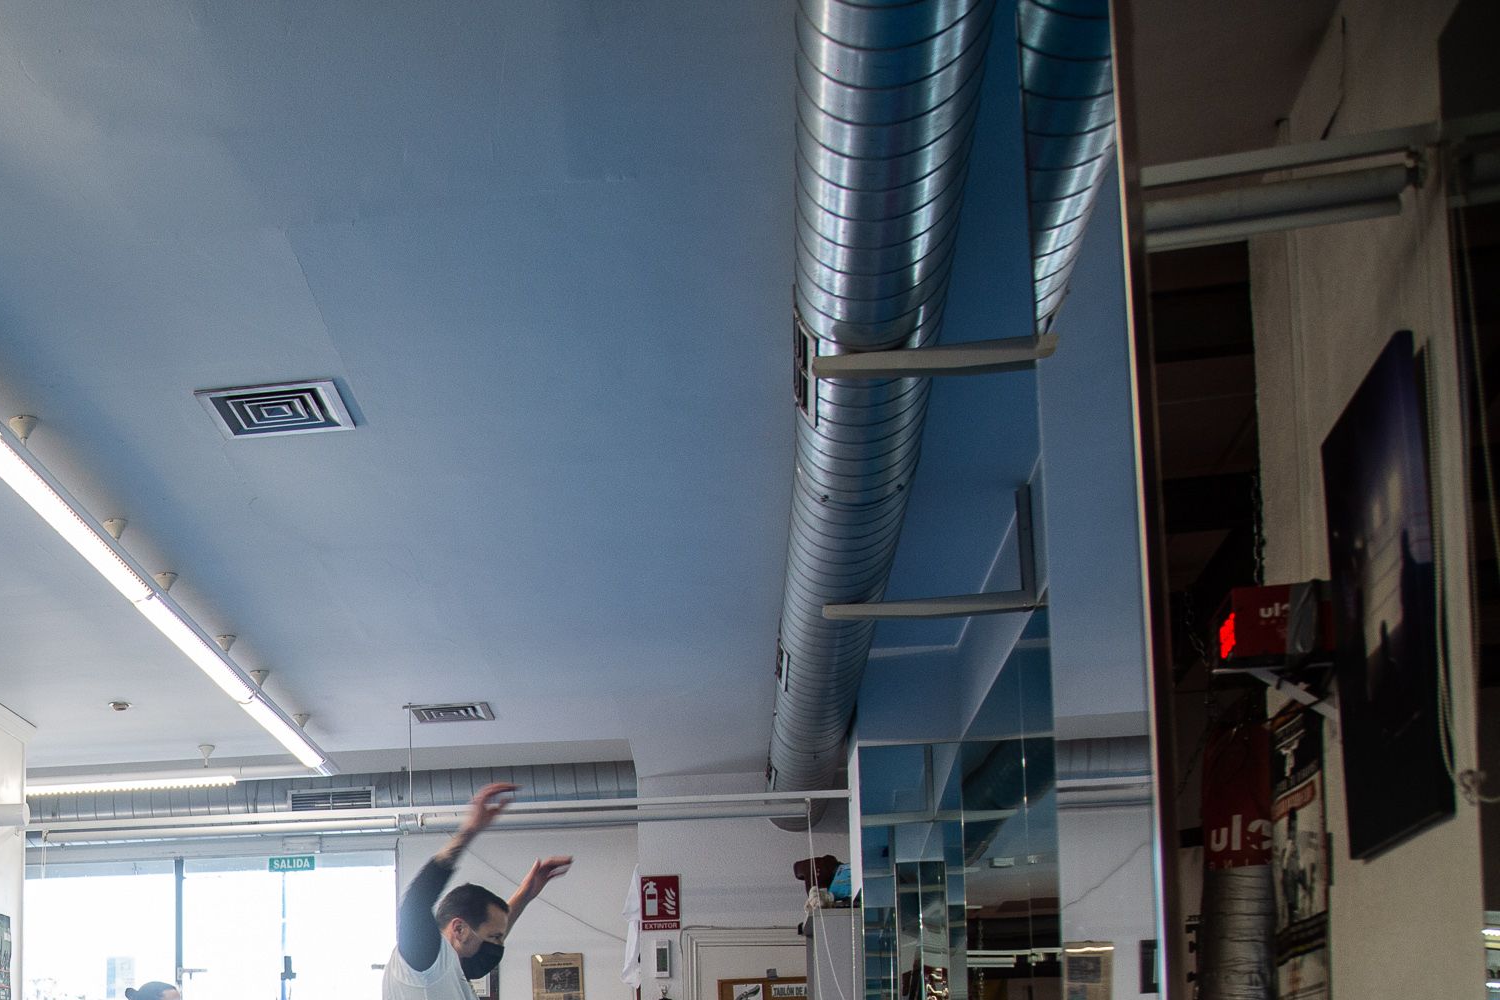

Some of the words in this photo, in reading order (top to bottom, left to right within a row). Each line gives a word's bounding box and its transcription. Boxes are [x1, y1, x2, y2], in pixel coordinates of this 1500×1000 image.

[273, 858, 310, 869] SALIDA
[644, 922, 678, 930] EXTINTOR
[773, 985, 795, 996] TABLÓN
[795, 986, 804, 996] DE
